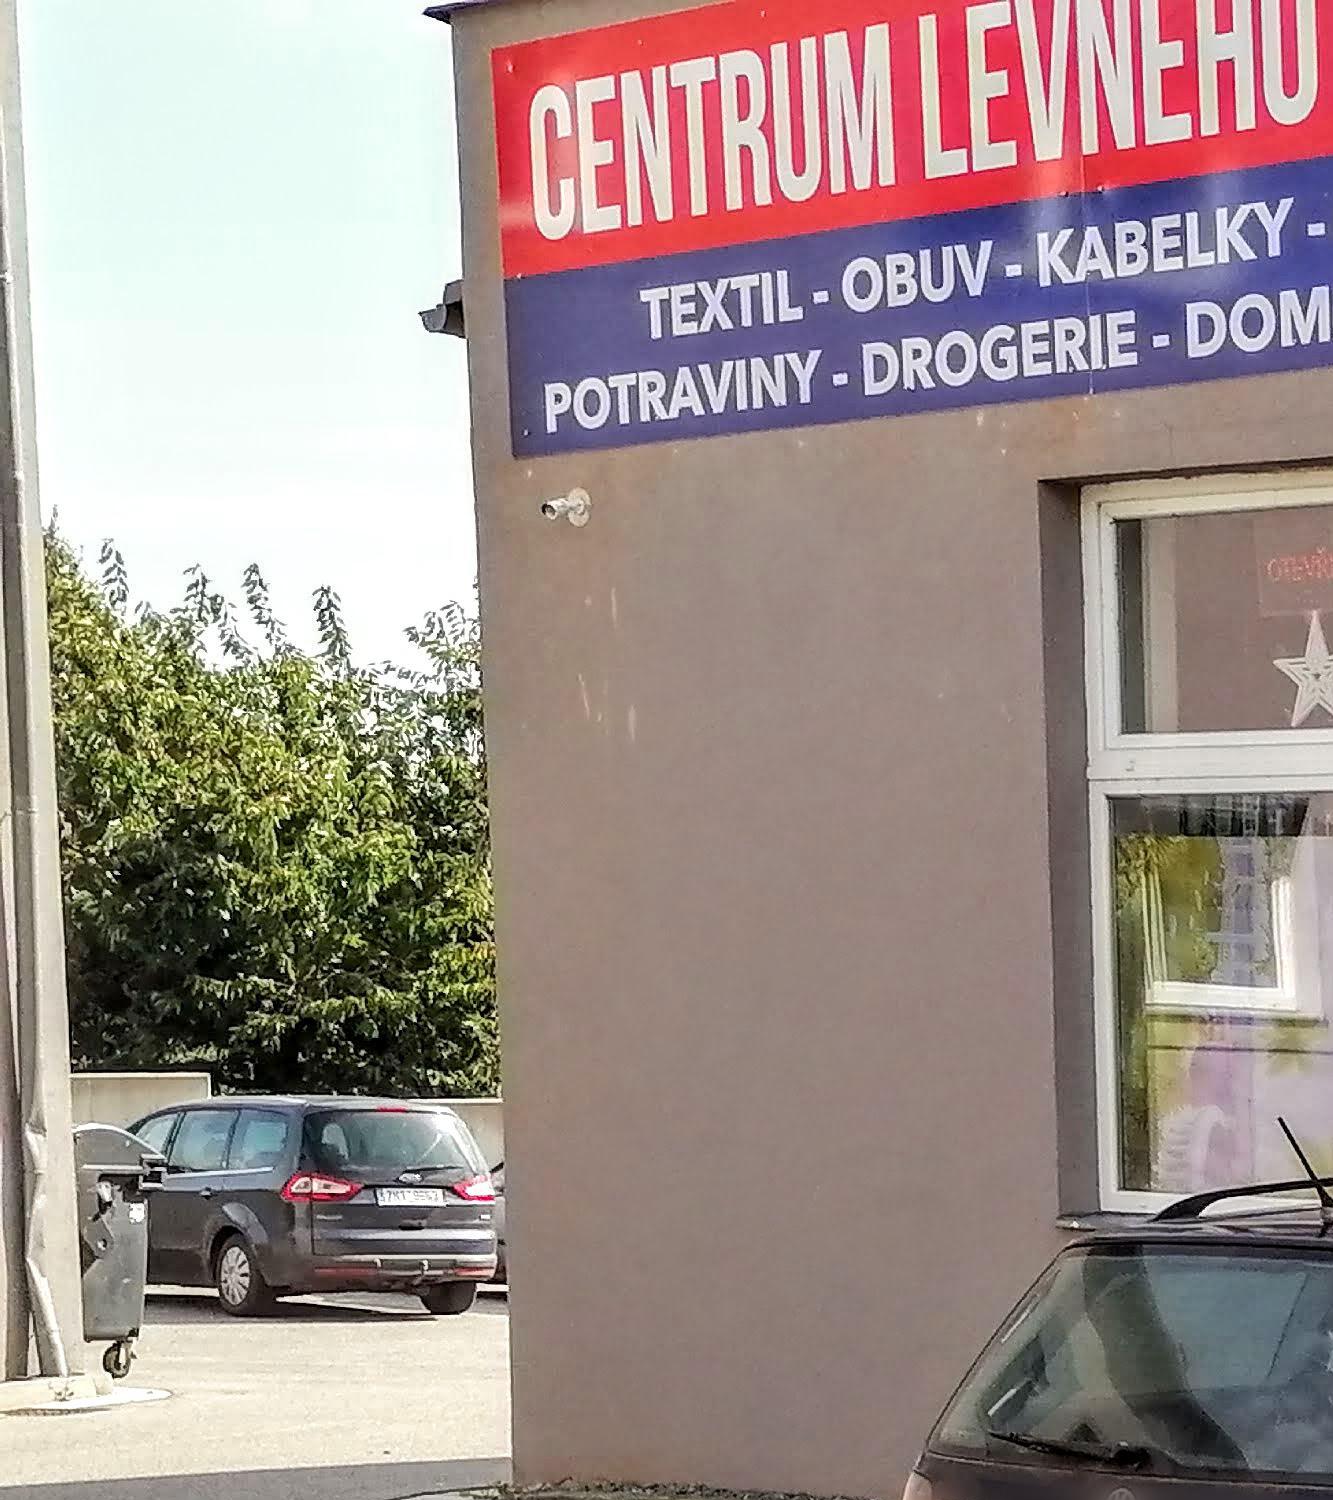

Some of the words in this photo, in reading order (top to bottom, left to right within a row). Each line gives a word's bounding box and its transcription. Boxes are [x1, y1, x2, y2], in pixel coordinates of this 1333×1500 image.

[529, 23, 895, 241] CENTRUM
[640, 270, 803, 340] TEXTIL
[841, 240, 993, 314] OBUV
[1037, 198, 1294, 288] KABELKY
[544, 349, 823, 433] POTRAVINY
[862, 309, 1138, 397] DROGERIE
